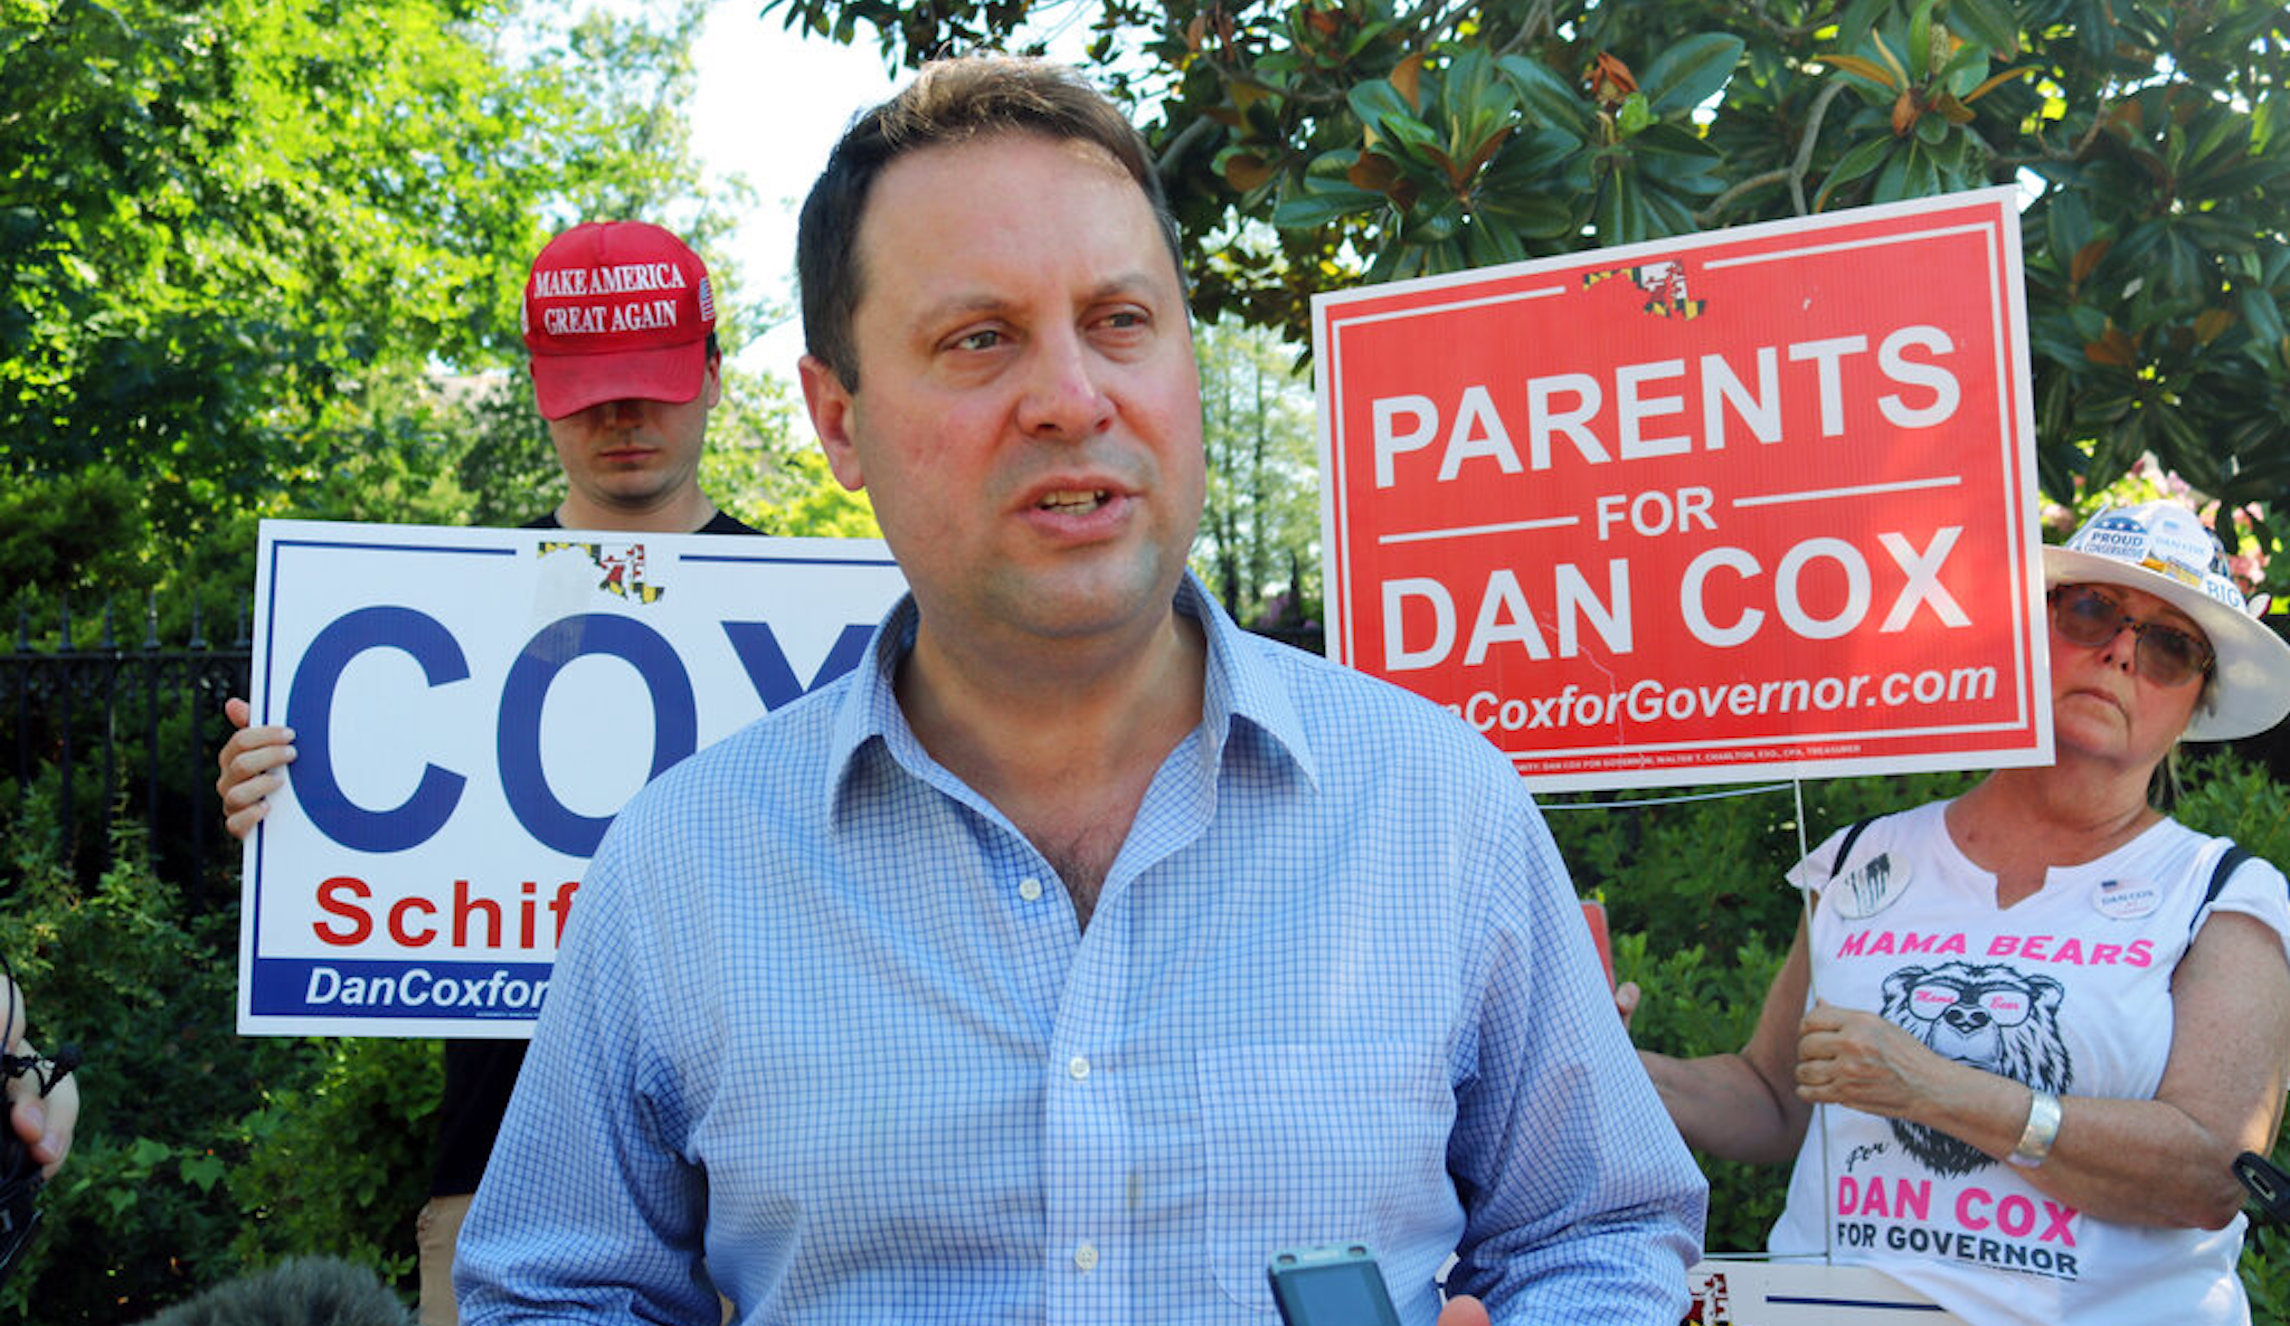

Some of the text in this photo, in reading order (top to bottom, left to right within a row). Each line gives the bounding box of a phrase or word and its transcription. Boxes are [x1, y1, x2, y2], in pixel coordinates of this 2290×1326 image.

[534, 263, 687, 298] MAKE AMERICA
[544, 300, 677, 335] GREAT AGAIN
[1372, 325, 1962, 489] PARENTS
[1598, 487, 1717, 541] FOR
[2092, 532, 2144, 547] PROUD
[1381, 525, 1972, 671] DAN COX
[1837, 930, 2155, 968] MAMA BEARS
[1914, 990, 2020, 1010] Mama Bear
[1847, 1141, 1889, 1173] for
[1838, 1176, 2081, 1248] DAN COX
[1838, 1223, 2079, 1276] FOR GOVERNOR
